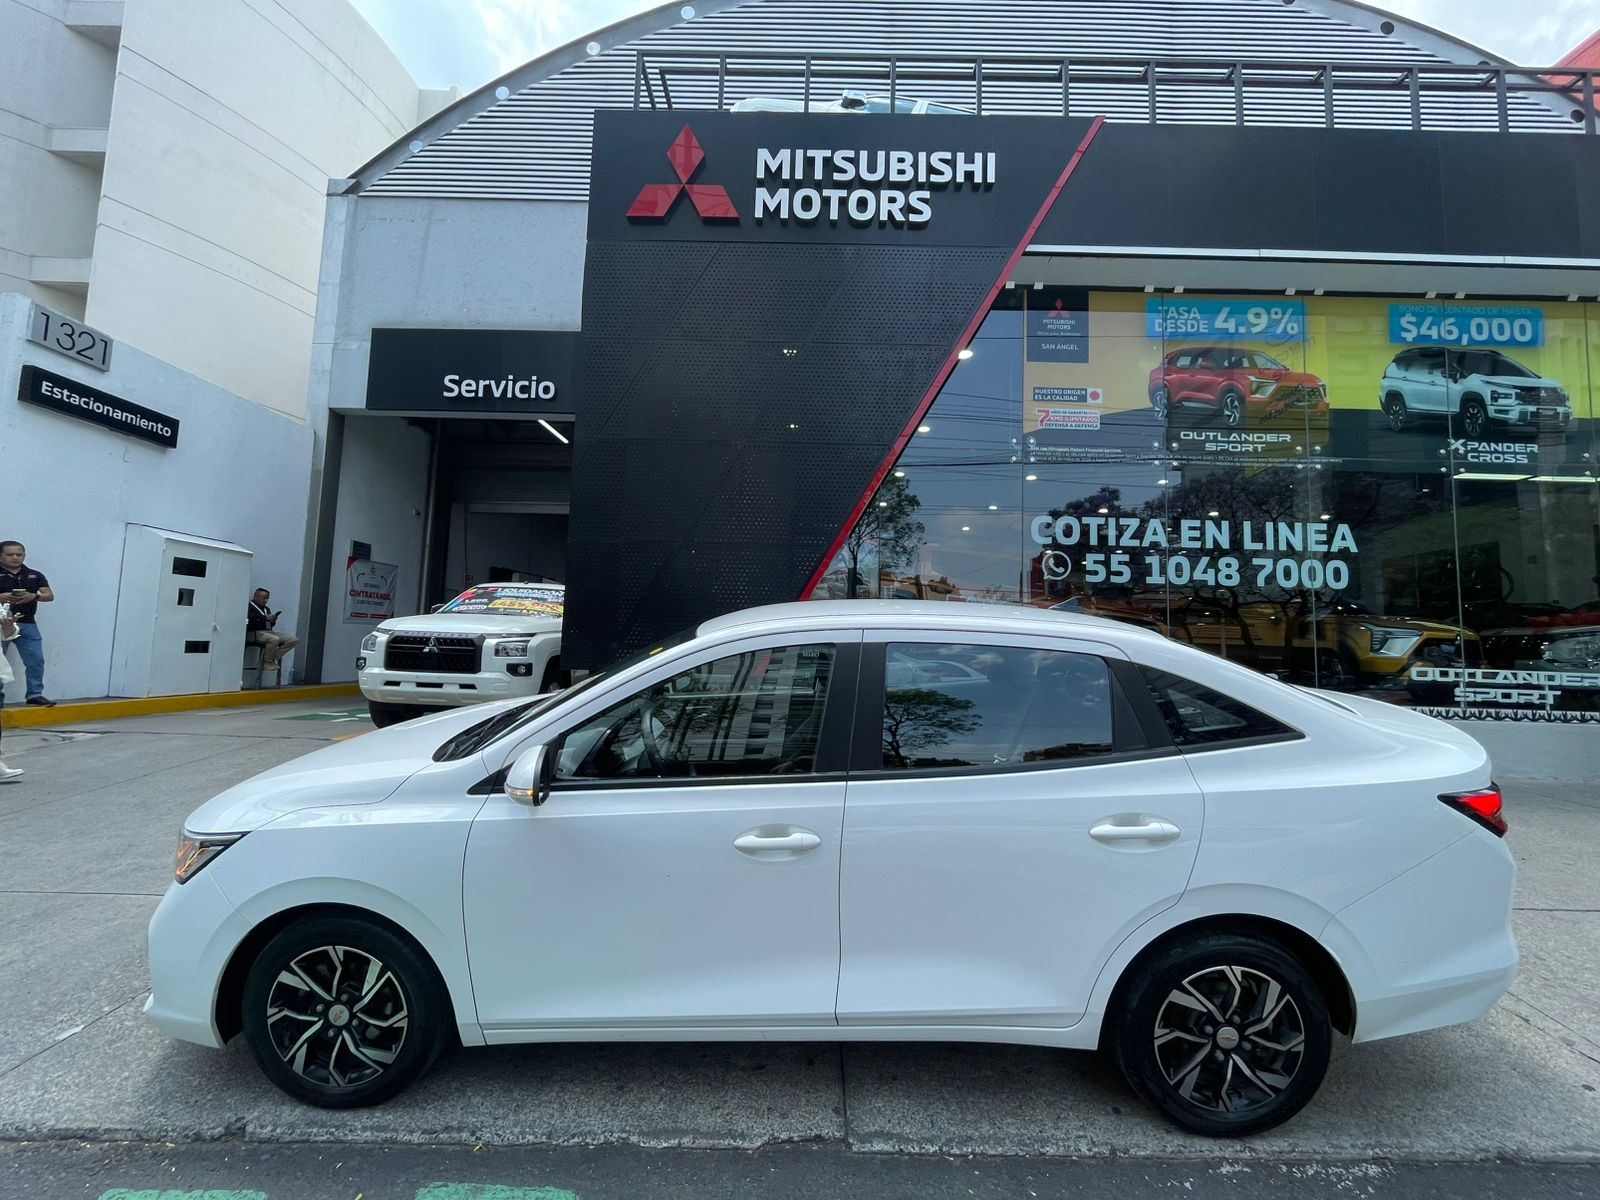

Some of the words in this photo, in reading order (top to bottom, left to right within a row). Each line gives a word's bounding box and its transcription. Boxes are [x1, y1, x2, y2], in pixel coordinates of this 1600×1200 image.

[756, 148, 996, 183] MITSUBISHI
[754, 187, 932, 222] MOTORS
[1157, 306, 1201, 320] TASA
[1426, 305, 1439, 313] DE
[1154, 319, 1209, 333] DESDE
[1213, 306, 1299, 335] 4.9%
[1400, 312, 1533, 346] $46,000
[40, 311, 109, 366] 1321
[1056, 342, 1079, 351] ÁNGEL
[442, 374, 556, 400] Servicio
[41, 380, 172, 438] Estacionamiento
[1036, 408, 1050, 428] 7
[1180, 431, 1292, 443] OUTLANDER
[1447, 438, 1540, 453] XPANDER
[1204, 442, 1266, 452] SPORT
[1467, 452, 1529, 464] CROSS
[1029, 515, 1169, 548] COTIZA
[1181, 518, 1230, 550] EN
[1243, 520, 1359, 553] LINEA
[1085, 553, 1132, 584] 55
[1144, 555, 1240, 586] 1048
[1251, 557, 1350, 590] 7000
[349, 589, 391, 601] CONTRATANDO
[498, 587, 565, 597] LIQUIDACIÓN
[1410, 667, 1600, 686] OUTLANDER
[1454, 686, 1562, 704] SPORT
